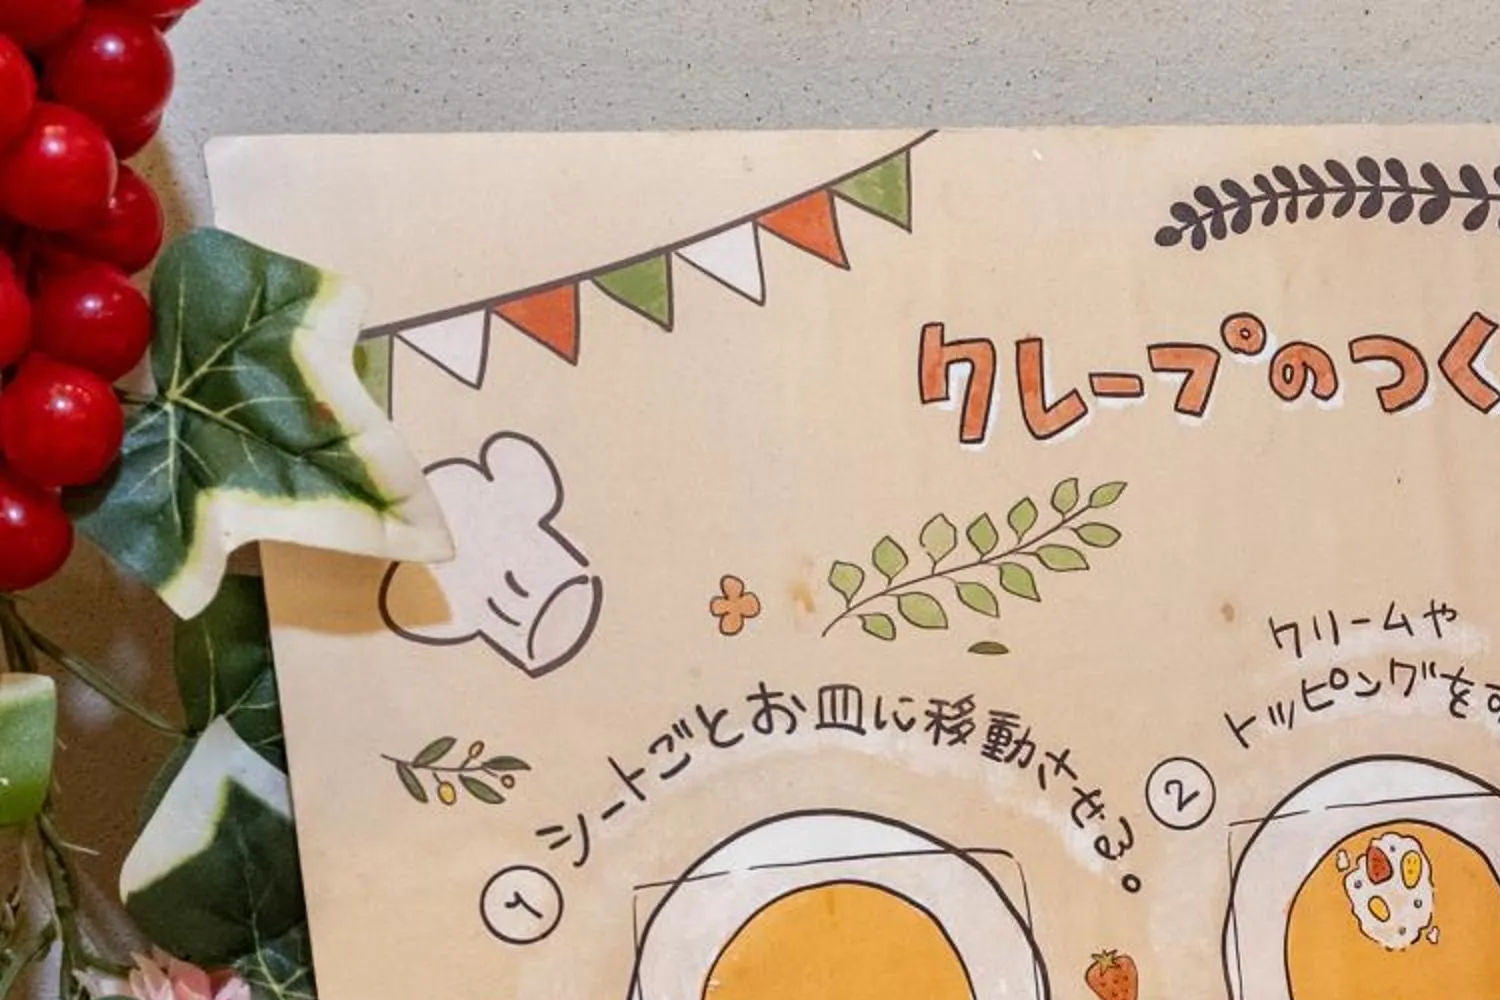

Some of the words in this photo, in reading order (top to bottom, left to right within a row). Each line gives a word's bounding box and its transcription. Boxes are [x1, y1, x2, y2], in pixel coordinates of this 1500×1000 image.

[1268, 599, 1457, 658] クリームや
[535, 681, 1142, 893] シートごとお皿に移動させる。
